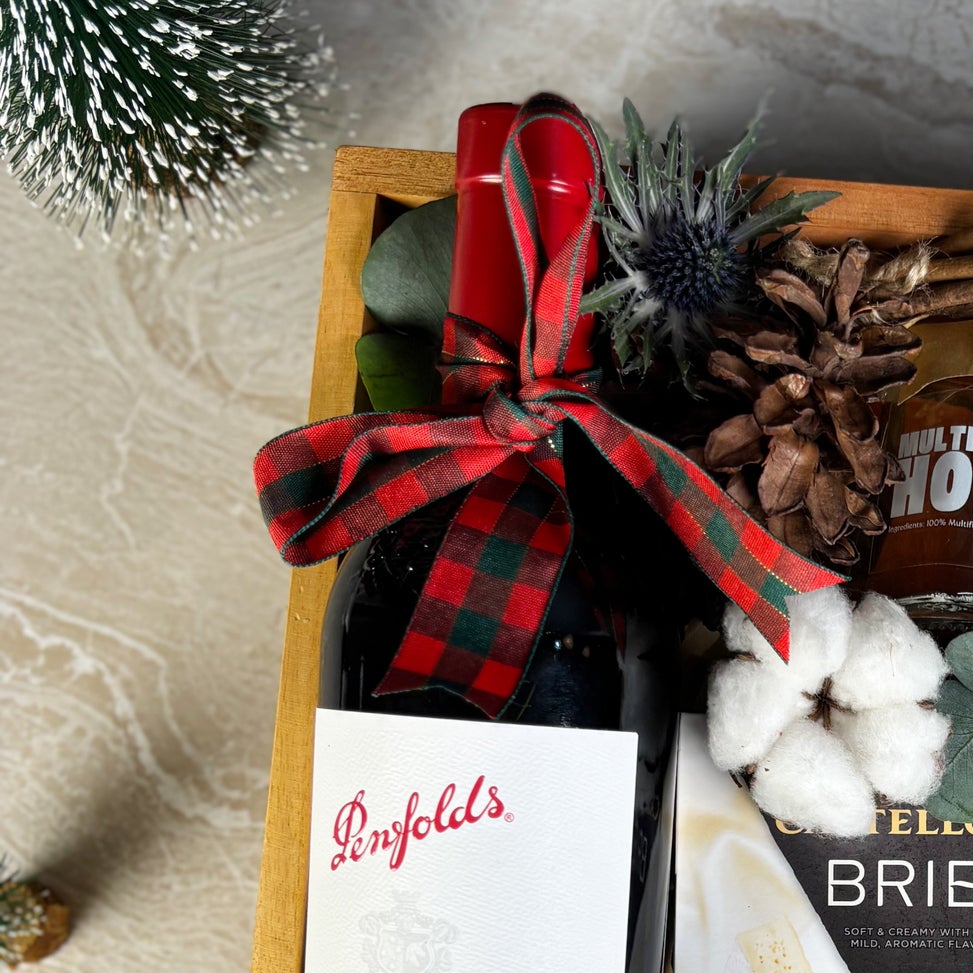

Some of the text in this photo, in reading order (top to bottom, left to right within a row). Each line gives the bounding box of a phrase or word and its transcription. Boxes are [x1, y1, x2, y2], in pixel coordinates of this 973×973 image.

[927, 519, 946, 527] 100%
[331, 775, 505, 871] Penfolds
[844, 927, 873, 936] SOFT
[877, 927, 885, 936] &
[889, 928, 936, 936] CREAMY
[940, 928, 969, 937] WITH
[850, 940, 881, 949] MILD,
[885, 940, 944, 949] AROMATIC
